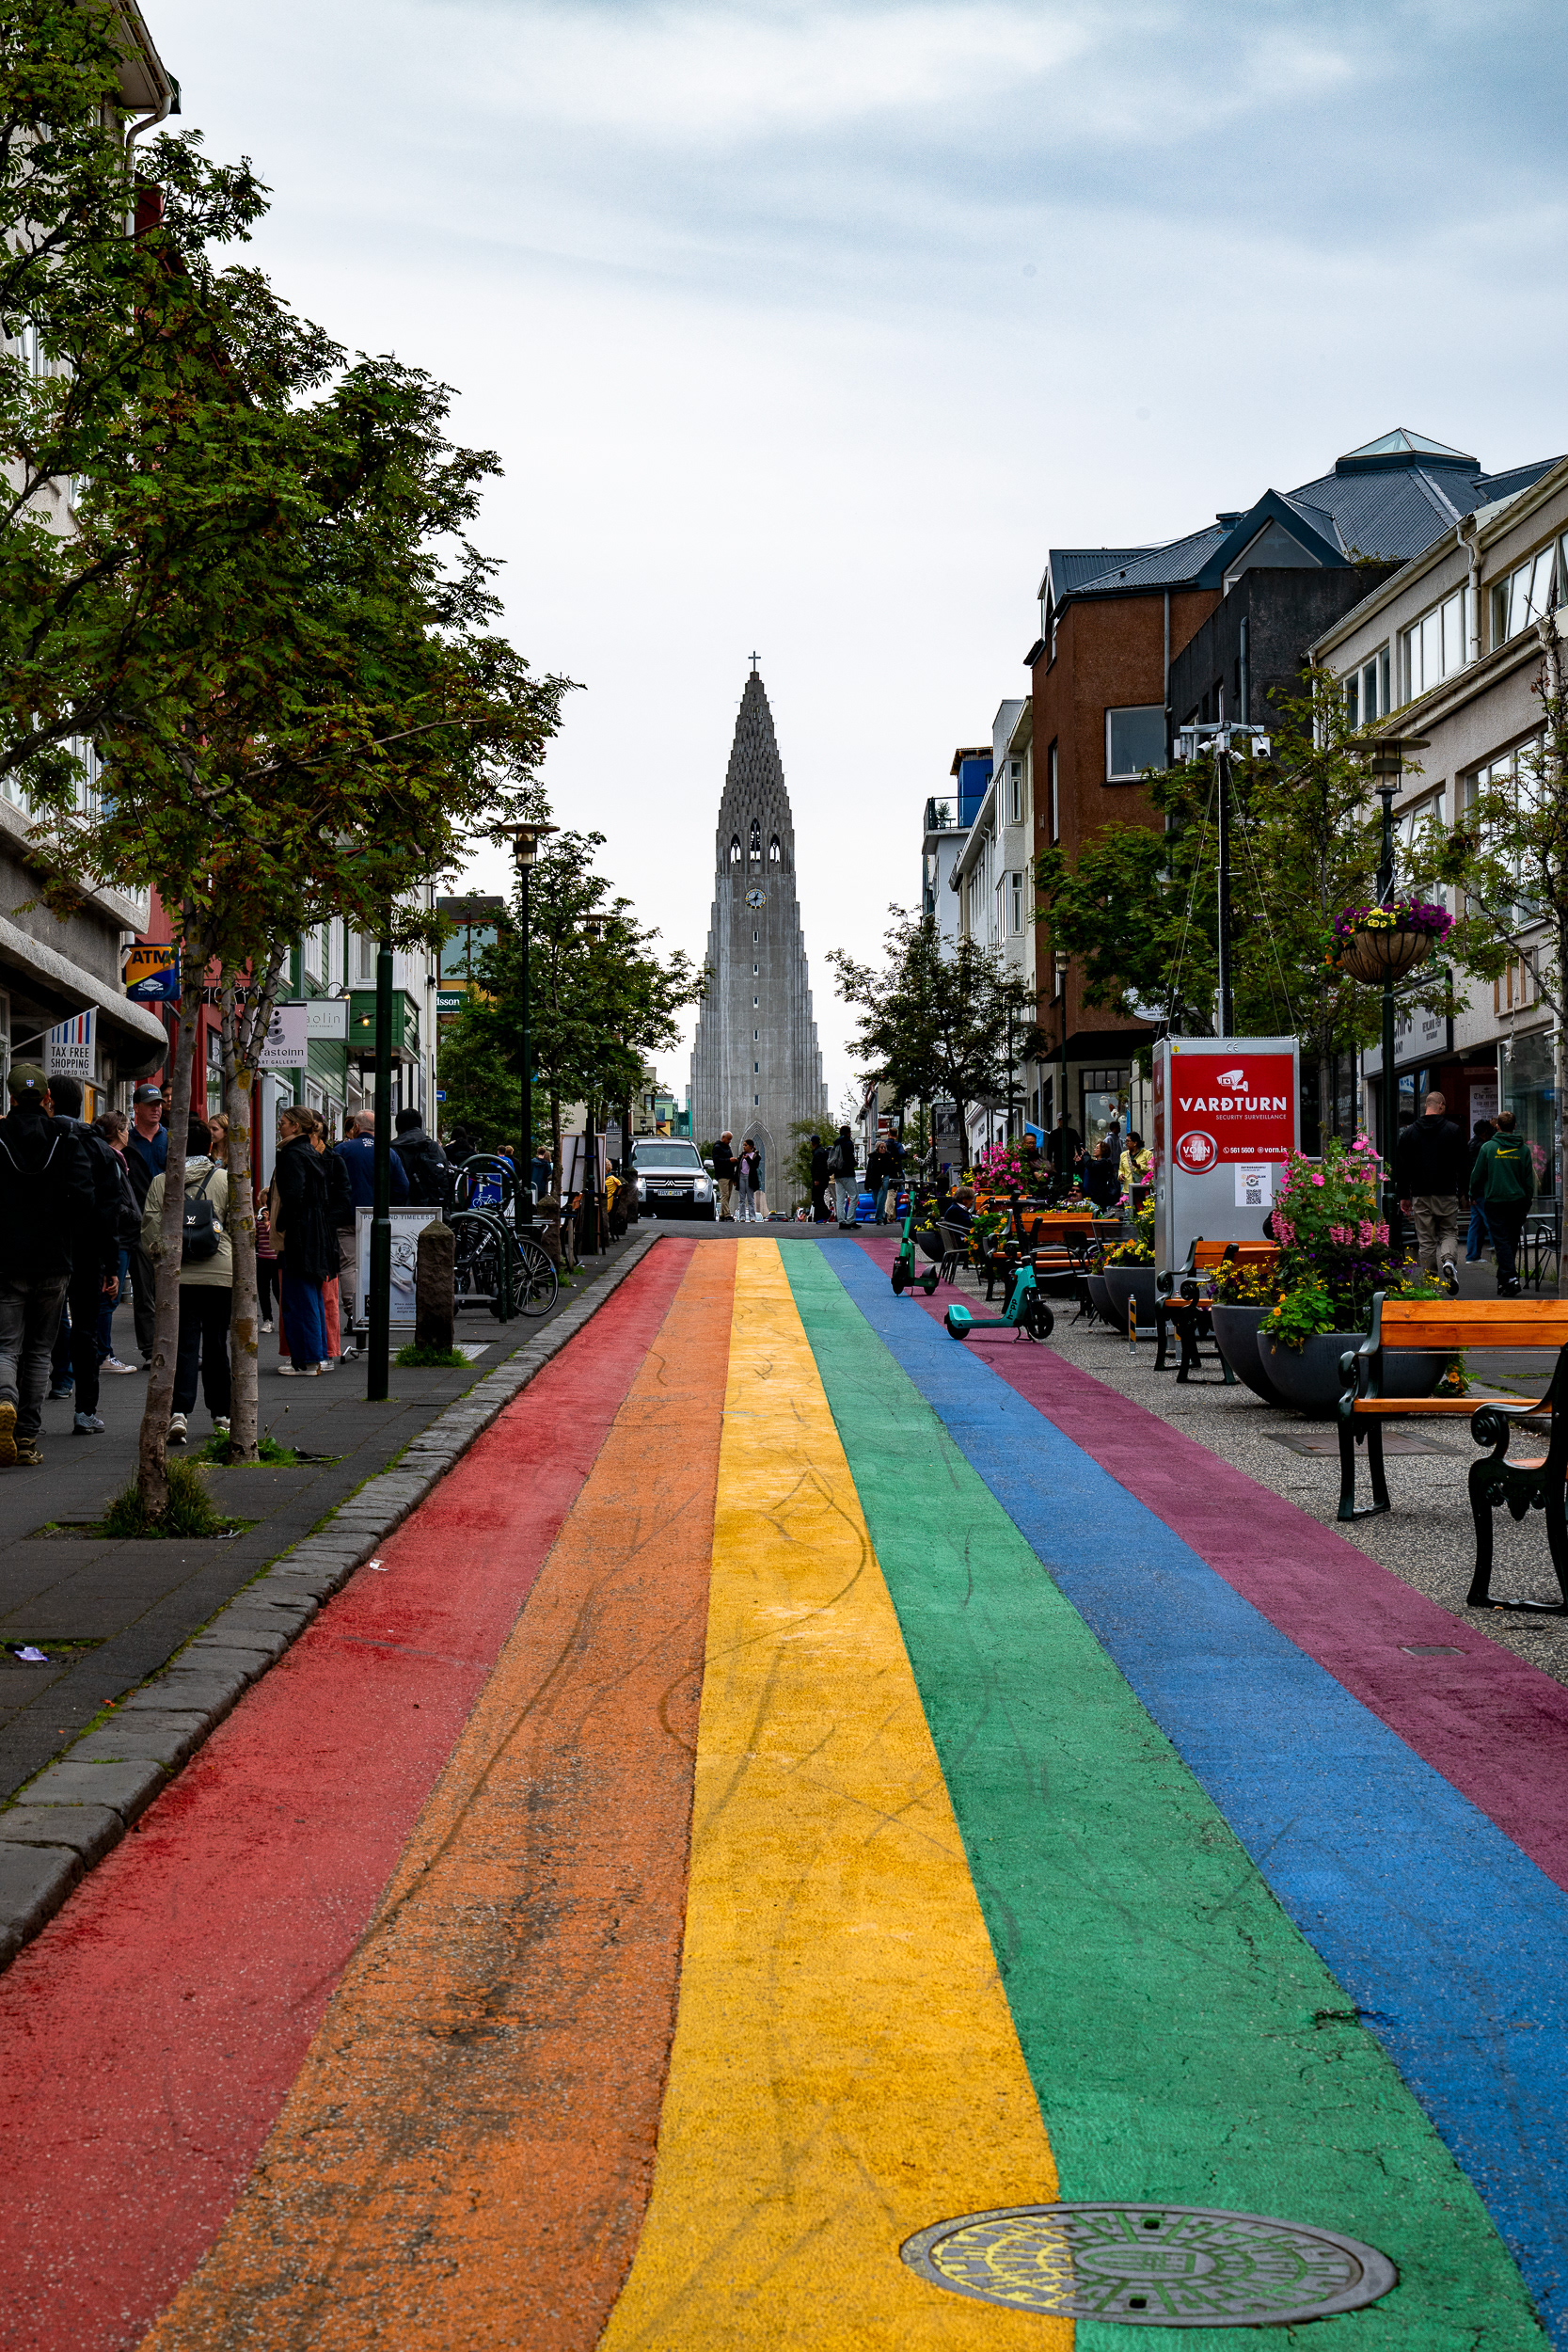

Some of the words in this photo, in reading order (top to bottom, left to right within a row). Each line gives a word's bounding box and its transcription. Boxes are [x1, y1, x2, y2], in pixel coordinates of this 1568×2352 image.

[132, 950, 171, 963] ATM
[51, 1046, 67, 1057] TAX
[70, 1046, 89, 1058] FREE
[51, 1057, 89, 1069] SHOPPING
[1179, 1097, 1287, 1112] VARÐTURN
